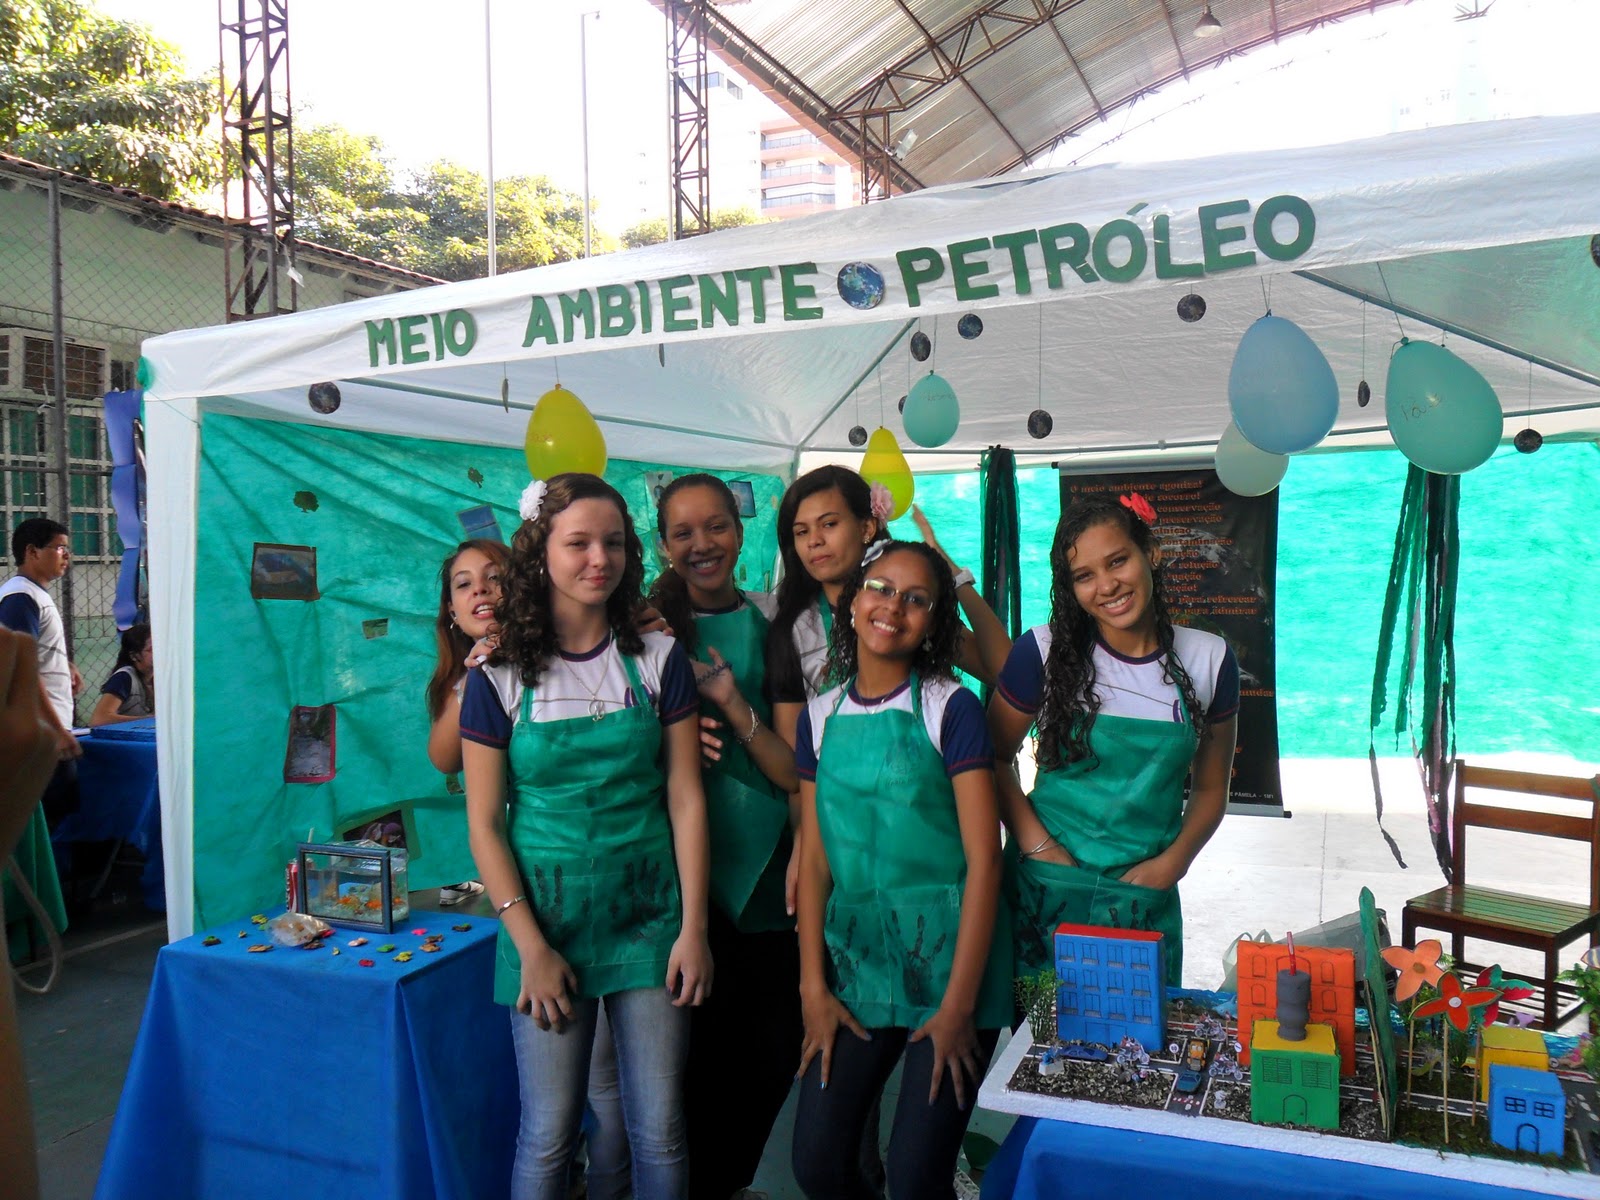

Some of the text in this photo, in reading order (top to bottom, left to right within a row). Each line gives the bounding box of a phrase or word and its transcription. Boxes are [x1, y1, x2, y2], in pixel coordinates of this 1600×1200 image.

[364, 194, 1316, 367] MEIO AMBIENTE PETRÓLEO
[1081, 484, 1105, 493] meio
[1108, 481, 1159, 492] ambiente
[1157, 502, 1222, 513] conservação
